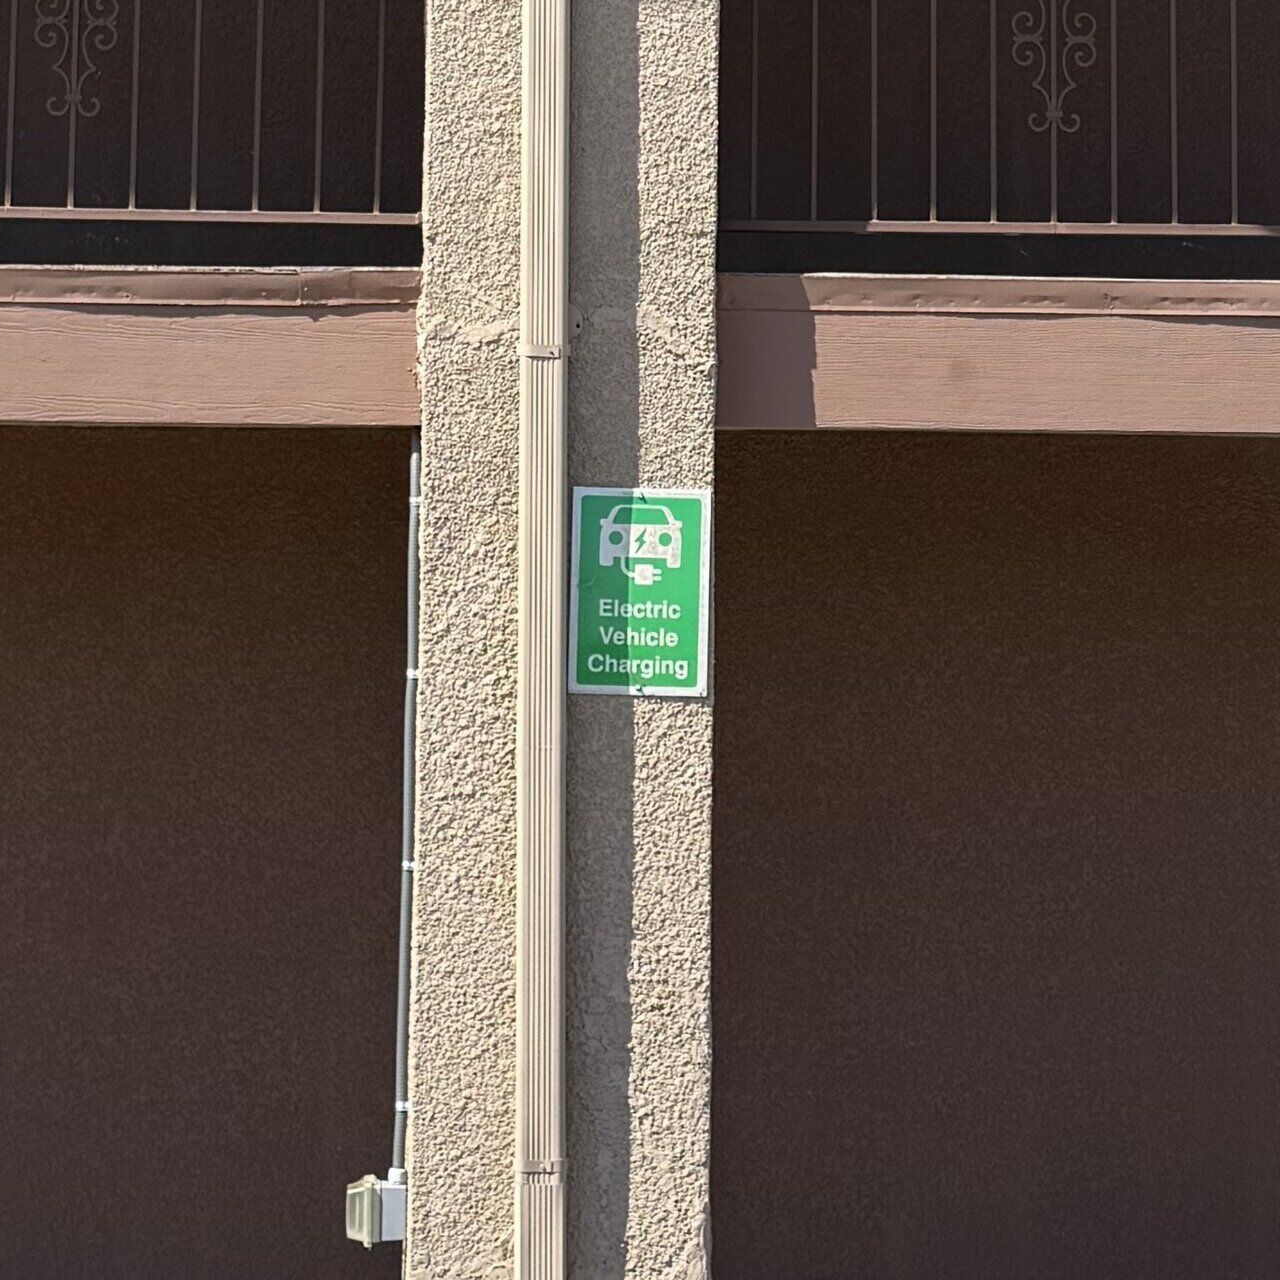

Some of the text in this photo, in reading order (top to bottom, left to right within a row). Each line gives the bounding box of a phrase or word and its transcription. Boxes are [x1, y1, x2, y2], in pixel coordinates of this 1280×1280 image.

[598, 599, 681, 619] Electric
[600, 626, 678, 646] Vehicle
[588, 654, 688, 679] Charging
